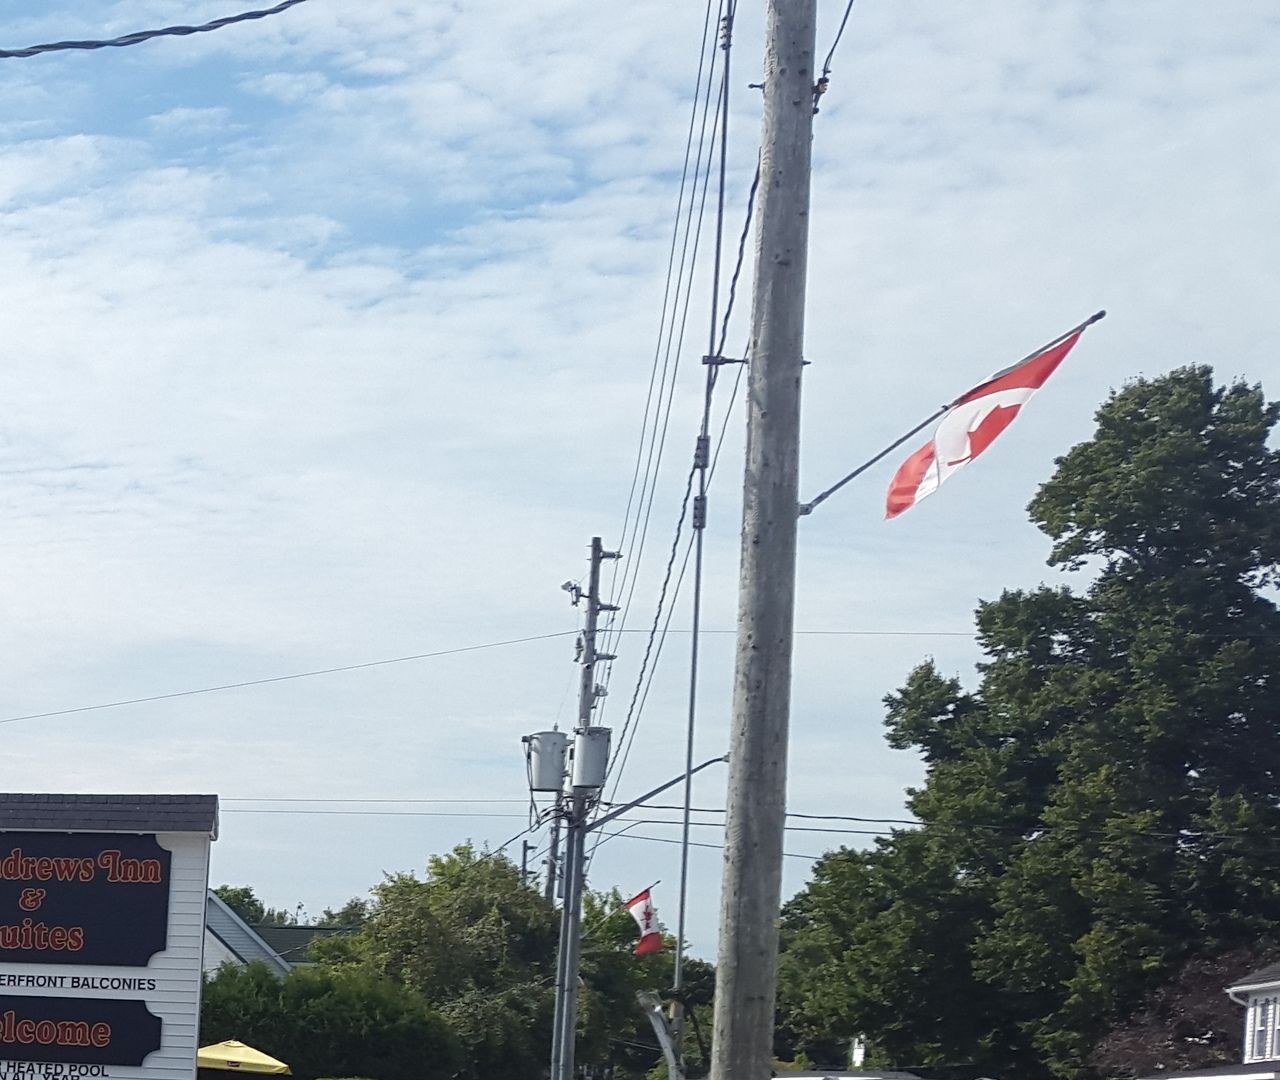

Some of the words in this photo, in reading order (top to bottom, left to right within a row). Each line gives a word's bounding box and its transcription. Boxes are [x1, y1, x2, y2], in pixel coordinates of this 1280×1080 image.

[98, 850, 161, 883] Inn
[19, 888, 47, 911] &
[71, 976, 157, 991] BALCONIES
[6, 1061, 64, 1076] HEATED
[68, 1064, 110, 1078] POOL
